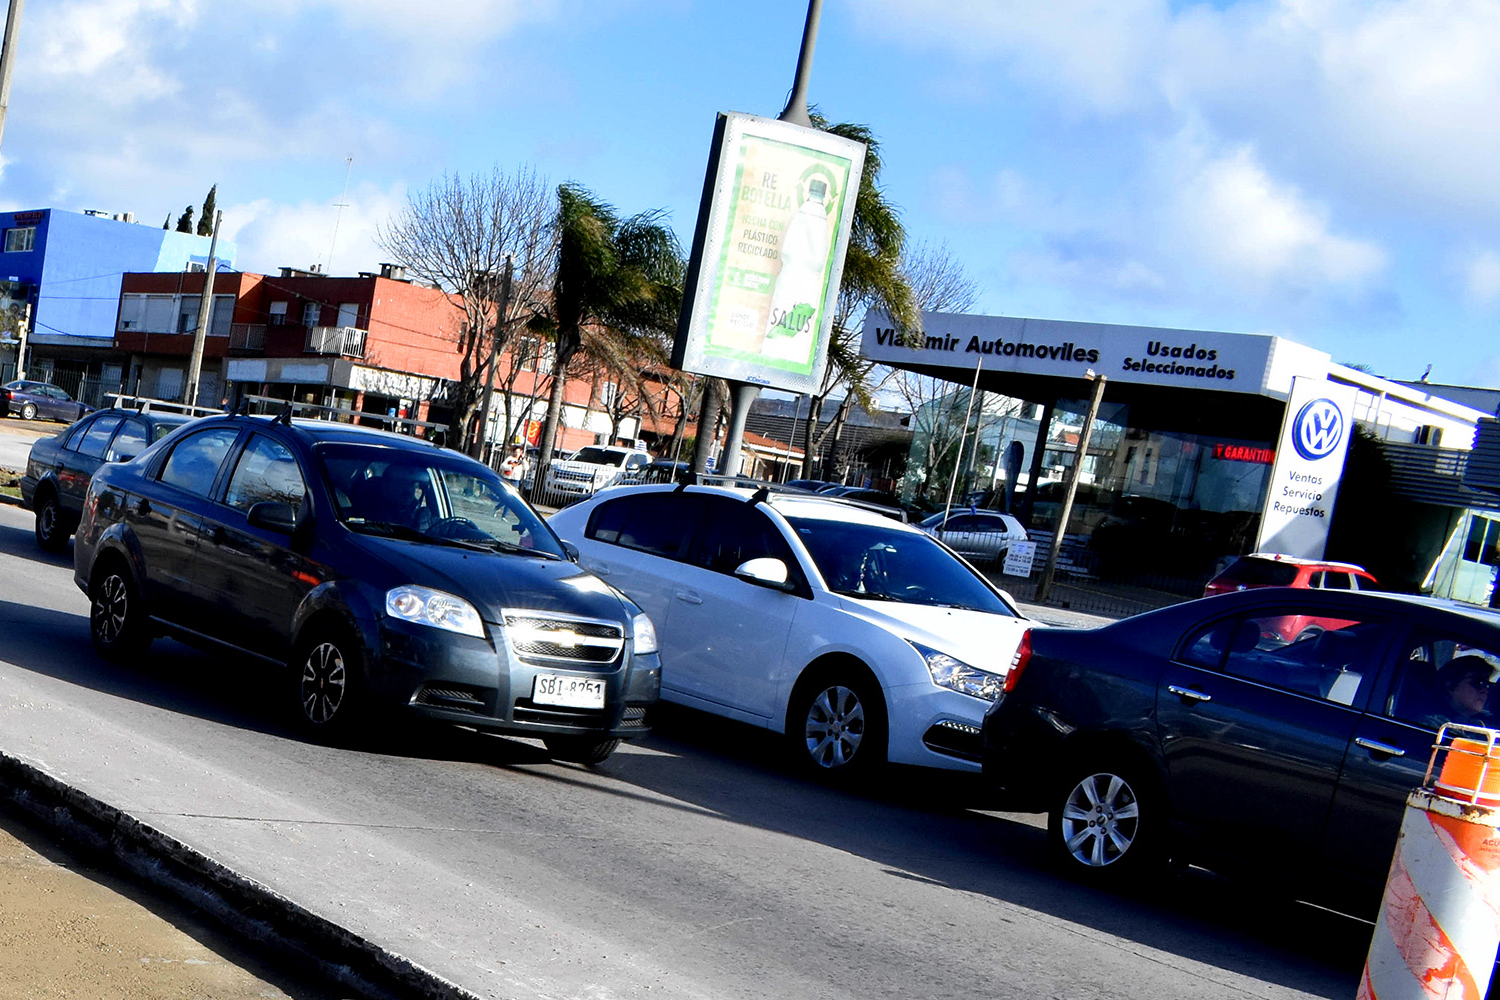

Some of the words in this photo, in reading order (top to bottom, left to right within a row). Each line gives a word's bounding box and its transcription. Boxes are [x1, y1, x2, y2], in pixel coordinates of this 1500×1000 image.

[762, 171, 778, 190] RE
[741, 185, 791, 211] BOTELLA
[743, 228, 778, 245] PLÁSTICO
[738, 242, 778, 259] RECICLADO
[771, 307, 812, 333] SALUS
[876, 328, 960, 352] Vlamir
[965, 335, 1100, 363] Automoviles
[1146, 341, 1217, 361] Usados
[1122, 357, 1235, 380] Seleccionados
[1289, 471, 1322, 485] Ventas
[1283, 486, 1322, 501] Servicio
[1274, 501, 1325, 518] Repuestos
[539, 678, 562, 695] SBI
